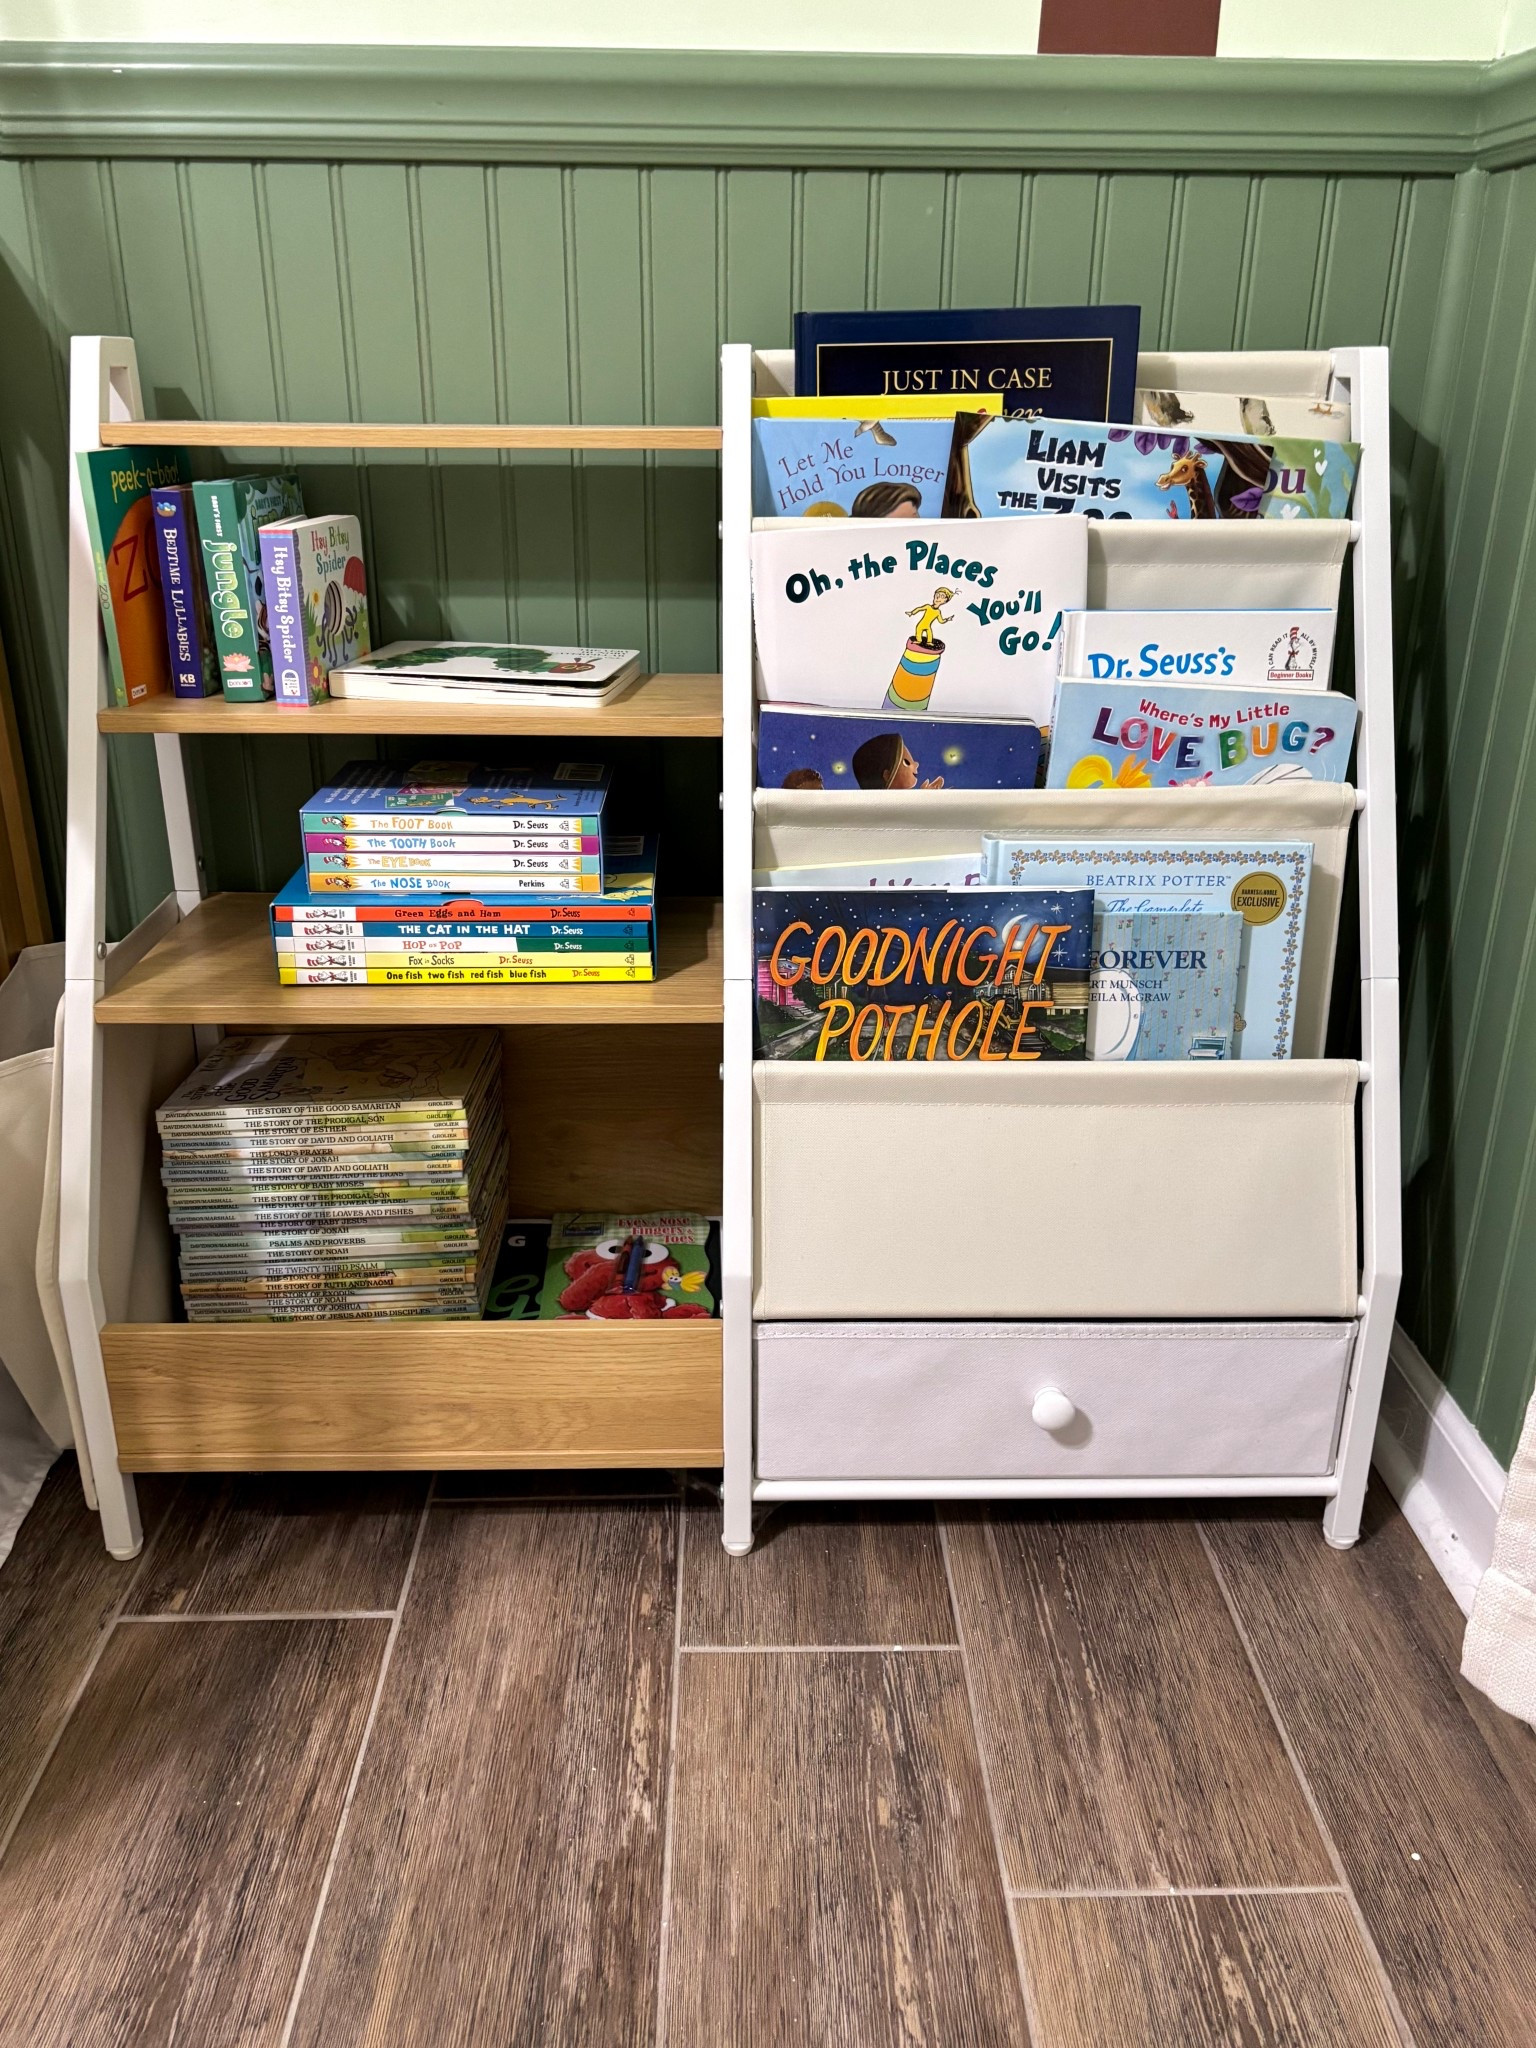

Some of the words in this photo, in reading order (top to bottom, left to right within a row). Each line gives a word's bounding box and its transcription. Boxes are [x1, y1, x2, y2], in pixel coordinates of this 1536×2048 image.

[883, 370, 942, 396] JUST
[951, 369, 980, 389] IN
[988, 368, 1052, 389] CASE
[1026, 430, 1107, 468] LIAM
[779, 453, 815, 478] Let
[821, 439, 853, 464] Me
[778, 474, 824, 510] Hold
[828, 464, 865, 485] You
[874, 458, 945, 484] Longer
[1037, 468, 1121, 498] VISITS
[998, 491, 1037, 509] THE
[311, 531, 327, 556] Itsy
[329, 527, 349, 551] Bitsy
[163, 528, 180, 584] BEDTIME
[271, 547, 288, 574] Itsy
[316, 551, 346, 582] Spider
[786, 568, 843, 603] Oh,
[848, 553, 897, 579] the
[906, 540, 998, 588] Places
[203, 540, 248, 638] jungle
[275, 577, 292, 613] Bitsy
[967, 590, 1041, 626] You'll
[171, 589, 191, 662] LULLABIES
[276, 615, 296, 662] Spider
[999, 611, 1062, 655] Go!
[1270, 638, 1282, 651] READ
[1300, 633, 1309, 641] ALL
[1088, 654, 1132, 678] Dr.
[1139, 644, 1236, 678] Seuss's
[180, 674, 195, 683] KB
[1139, 699, 1204, 728] Where's
[1209, 713, 1230, 730] My
[1237, 702, 1290, 724] Little
[1092, 706, 1204, 770] LOVE
[1218, 721, 1334, 770] BUG?
[370, 820, 388, 828] The
[392, 817, 424, 829] FOOT
[513, 821, 525, 829] Dr.
[527, 820, 548, 829] Seuss
[367, 839, 386, 847] The
[390, 838, 427, 848] TOOTH
[513, 840, 525, 848] Dr.
[527, 840, 548, 848] Seuss
[382, 856, 408, 867] EYE
[513, 859, 525, 868] Dr.
[527, 859, 548, 868] Seuss
[371, 879, 386, 887] The
[390, 877, 422, 888] NOSE
[1086, 875, 1156, 886] BEATRIX
[1237, 897, 1280, 907] EXCLUSIVE
[430, 910, 453, 918] Eggs
[551, 909, 561, 918] Dr.
[563, 908, 580, 917] Seuss
[398, 925, 421, 934] THE
[427, 925, 452, 934] CAT
[457, 925, 470, 934] IN
[476, 926, 498, 934] THE
[504, 925, 530, 934] HAT
[551, 926, 562, 935] Dr.
[563, 925, 583, 935] Seuss
[565, 942, 582, 950] Seuss
[770, 919, 1071, 987] GOODNIGHT
[409, 956, 422, 965] Fox
[431, 955, 454, 965] Socks
[499, 956, 511, 964] Dr.
[512, 955, 533, 964] Seuss
[387, 971, 403, 979] One
[406, 971, 422, 979] fish
[448, 970, 464, 979] fish
[487, 970, 503, 978] fish
[510, 970, 527, 978] blue
[530, 970, 546, 978] fish
[583, 969, 600, 977] Seuss
[1109, 980, 1163, 988] MUNSCH
[1120, 993, 1171, 1001] McGRAW
[815, 999, 1054, 1061] POTHOLE
[294, 1106, 305, 1114] OF
[307, 1105, 324, 1113] THE
[326, 1104, 350, 1112] GOOD
[352, 1102, 400, 1111] SAMARITAN
[264, 1119, 293, 1127] STORY
[368, 1115, 385, 1123] SON
[310, 1136, 336, 1144] DAVID
[357, 1134, 394, 1142] GOLIATH
[365, 1209, 383, 1217] AND
